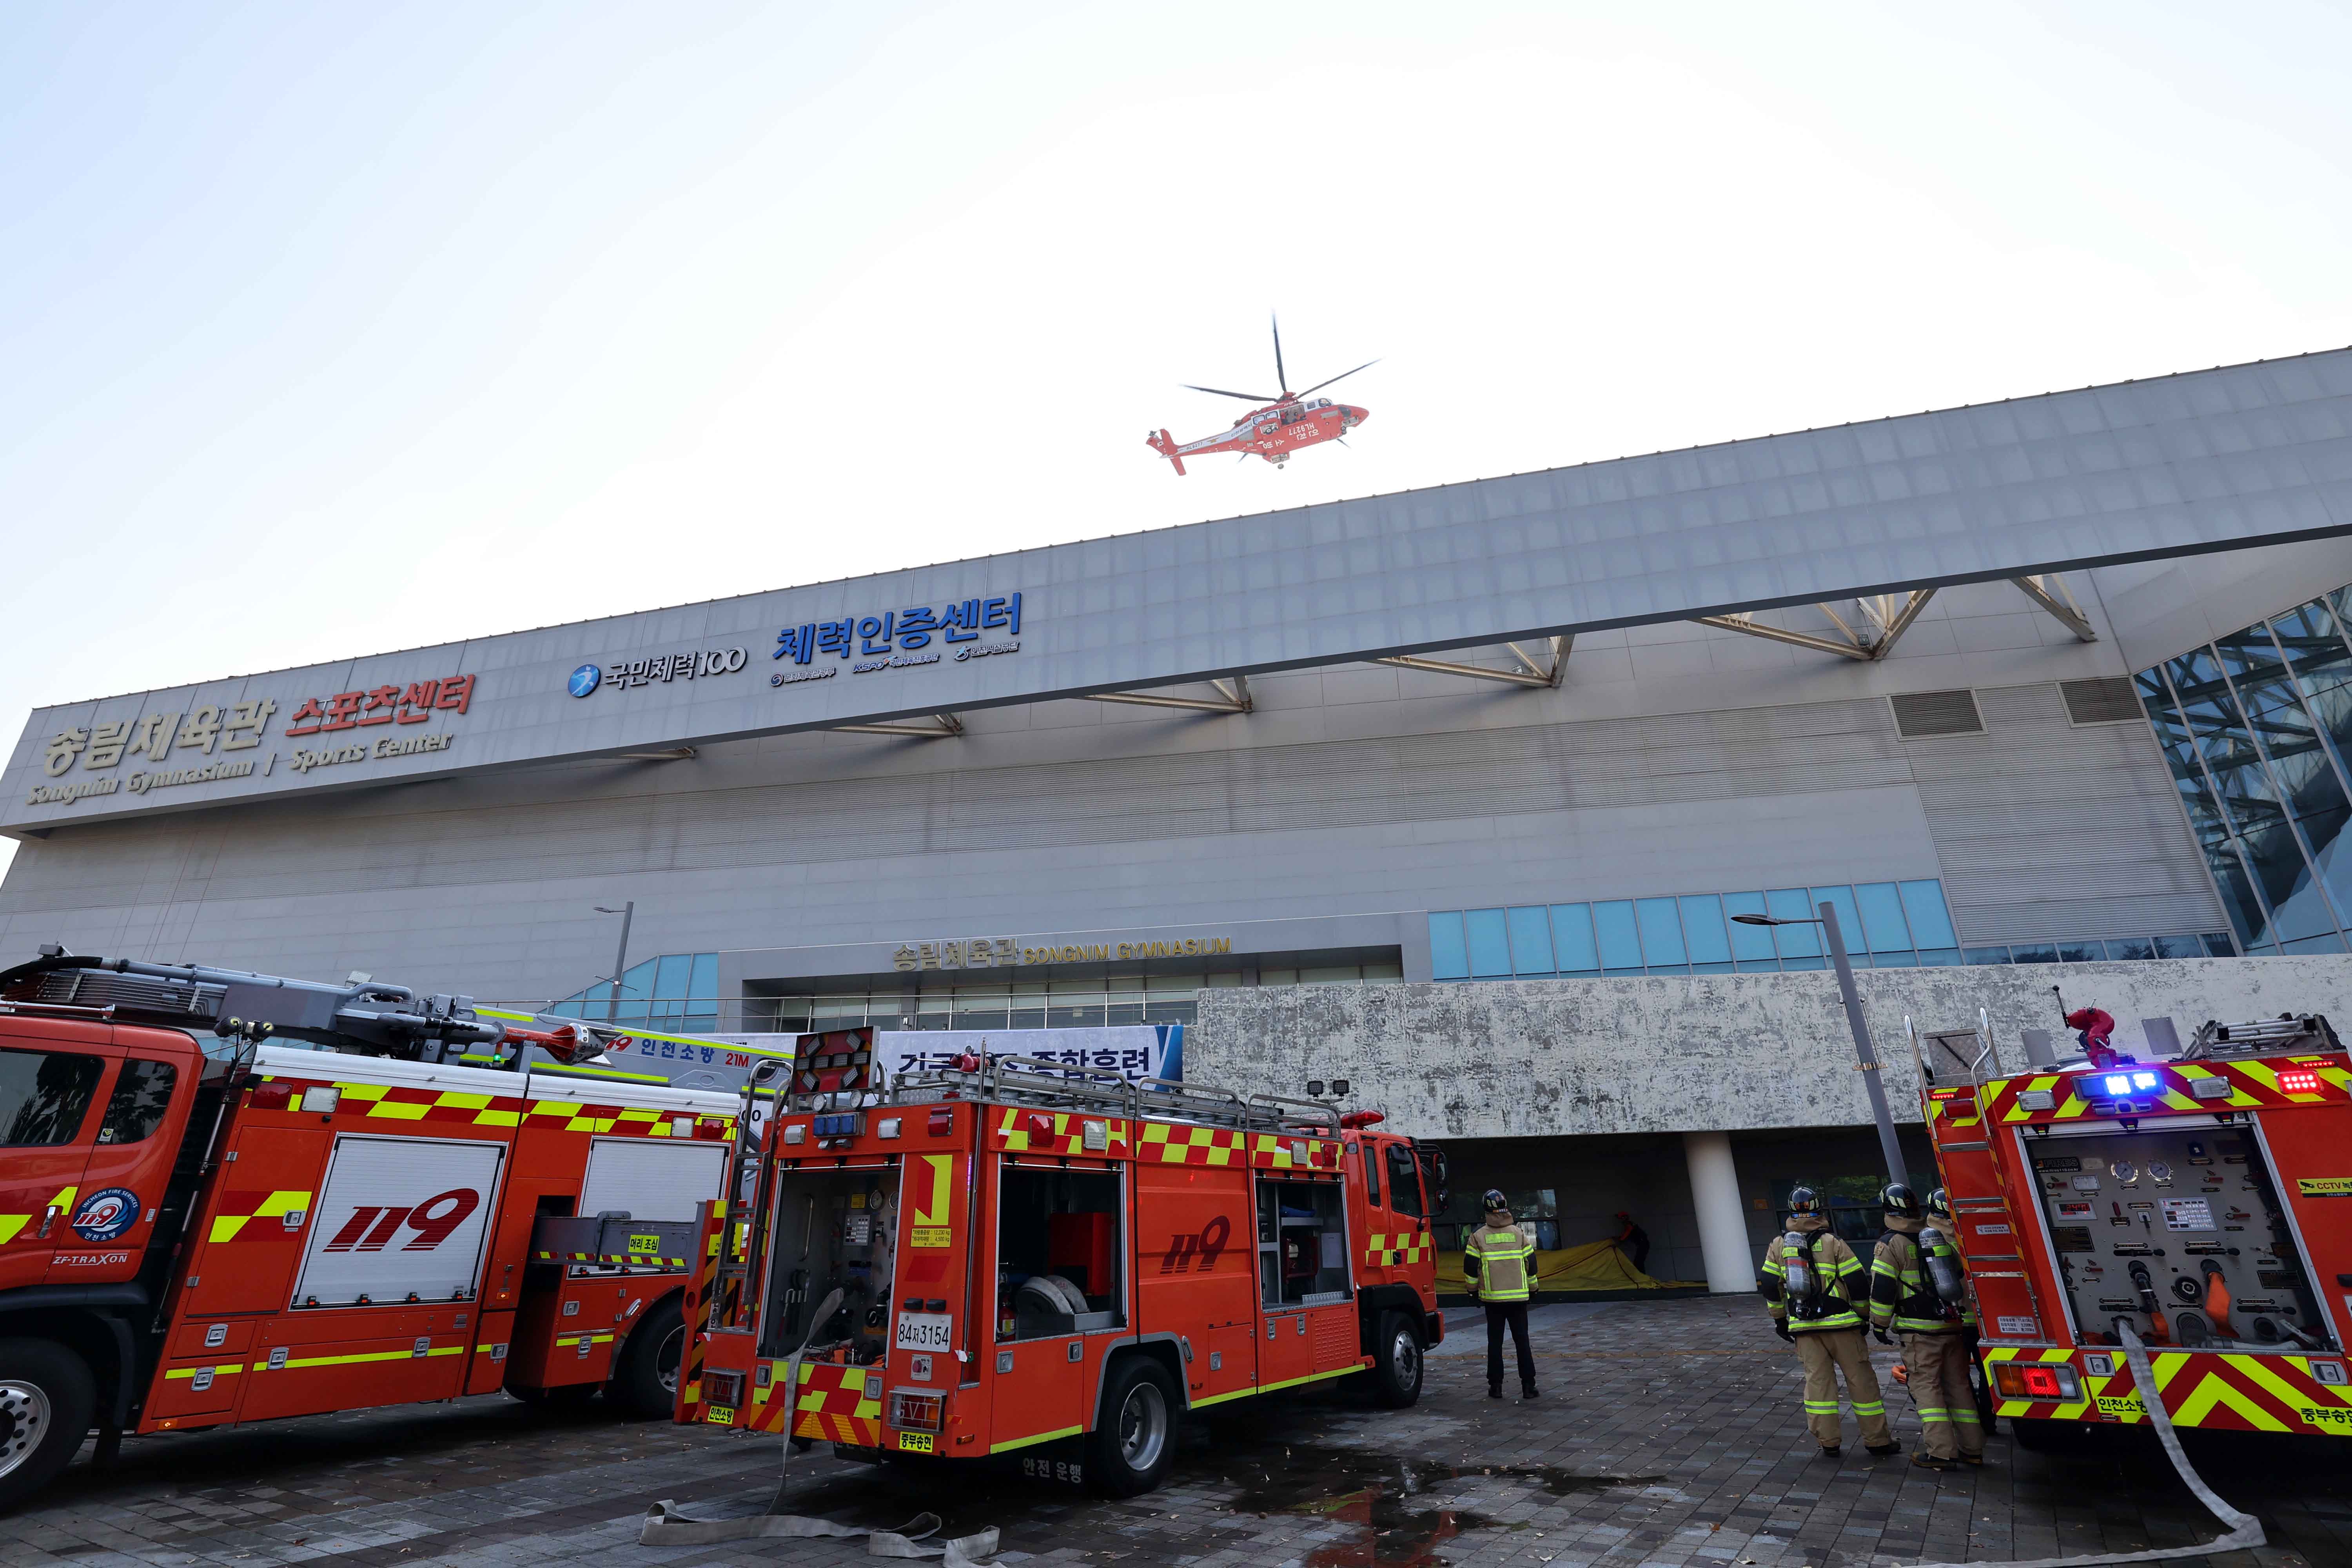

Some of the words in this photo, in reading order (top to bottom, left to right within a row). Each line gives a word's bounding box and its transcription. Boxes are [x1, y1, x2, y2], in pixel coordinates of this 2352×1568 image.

[1289, 423, 1314, 436] HL9277
[772, 592, 1021, 664] 체력인증센터
[971, 642, 1019, 657] 인천시설공단
[605, 646, 746, 689] 국민체력100
[853, 662, 884, 673] KSPO
[889, 653, 939, 666] 국민체육진흥공단
[784, 667, 835, 682] 문화체육관광부
[43, 697, 276, 776] 송림체육관
[285, 674, 475, 736] 스포츠센터
[26, 777, 119, 805] Songnim
[125, 760, 254, 794] Gymnasium
[289, 742, 365, 772] Sports
[370, 733, 452, 758] Center
[893, 937, 1020, 971] 송림체육관
[1024, 944, 1109, 964] SONGNIM
[1116, 937, 1232, 959] GYMNASIUM
[725, 1053, 750, 1068] 21M
[82, 1191, 107, 1208] INCHEON
[121, 1190, 138, 1208] SERVICES
[73, 1204, 119, 1226] 119
[322, 1187, 479, 1252] 119
[630, 1238, 643, 1250] 머리
[644, 1238, 659, 1251] 조심
[1160, 1215, 1230, 1274] 119
[53, 1253, 128, 1266] ZF-TRAXON
[898, 1323, 949, 1346] 84저3154
[709, 1407, 733, 1423] 인천소방
[901, 1434, 933, 1451] 중부송현
[1022, 1458, 1050, 1478] 안전
[1056, 1462, 1082, 1483] 운행
